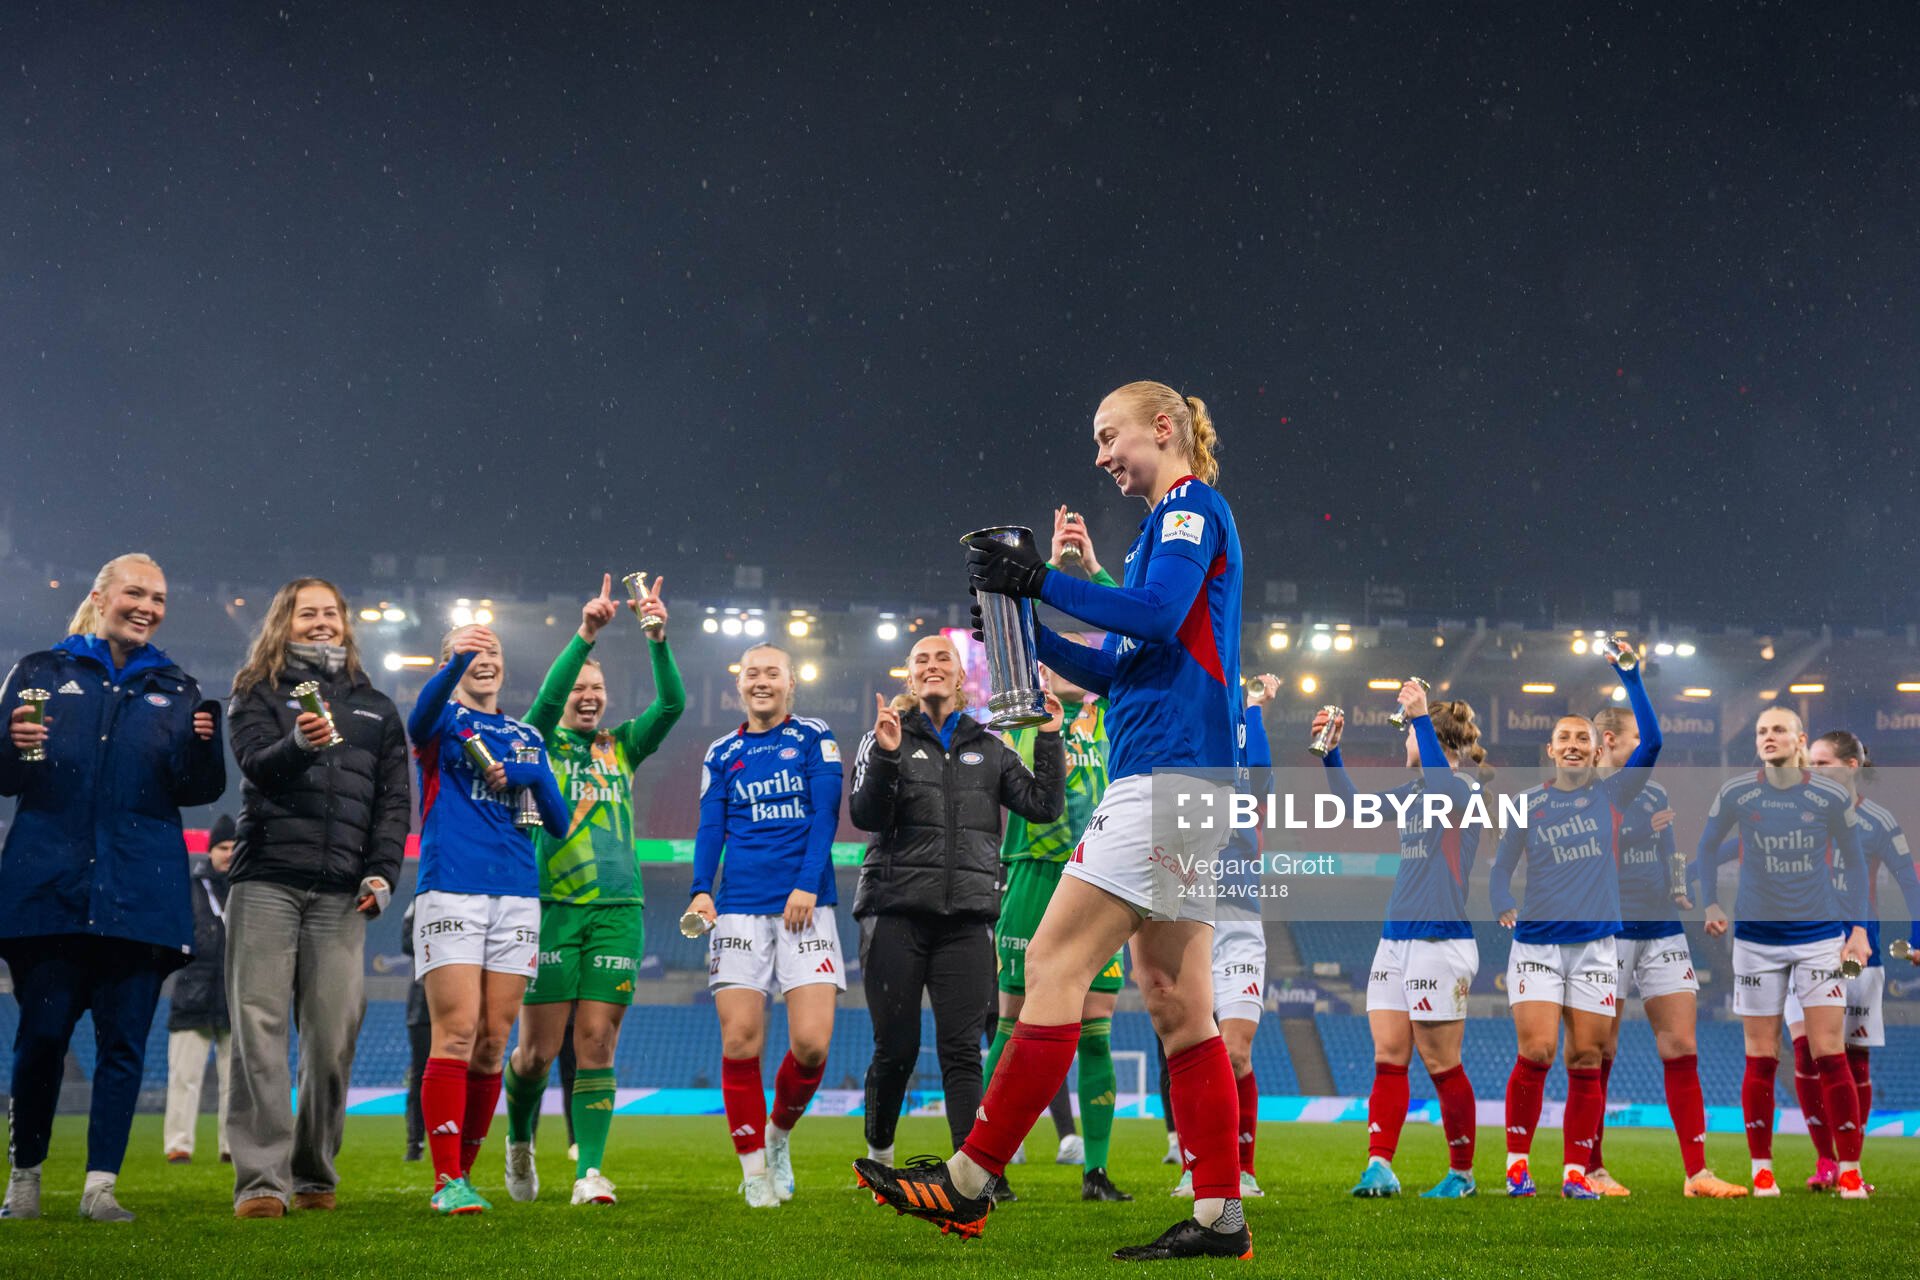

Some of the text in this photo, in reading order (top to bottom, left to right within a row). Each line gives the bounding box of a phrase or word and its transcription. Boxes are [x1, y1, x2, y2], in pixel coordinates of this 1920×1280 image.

[1066, 748, 1101, 767] ank
[571, 780, 621, 803] Bank
[734, 769, 804, 804] Aprila
[752, 797, 806, 822] Bank
[1534, 814, 1598, 846] Aprila
[1752, 829, 1815, 854] Aprila
[1553, 836, 1602, 864] Bank
[1765, 854, 1813, 873] Bank
[1519, 979, 1525, 994] 6
